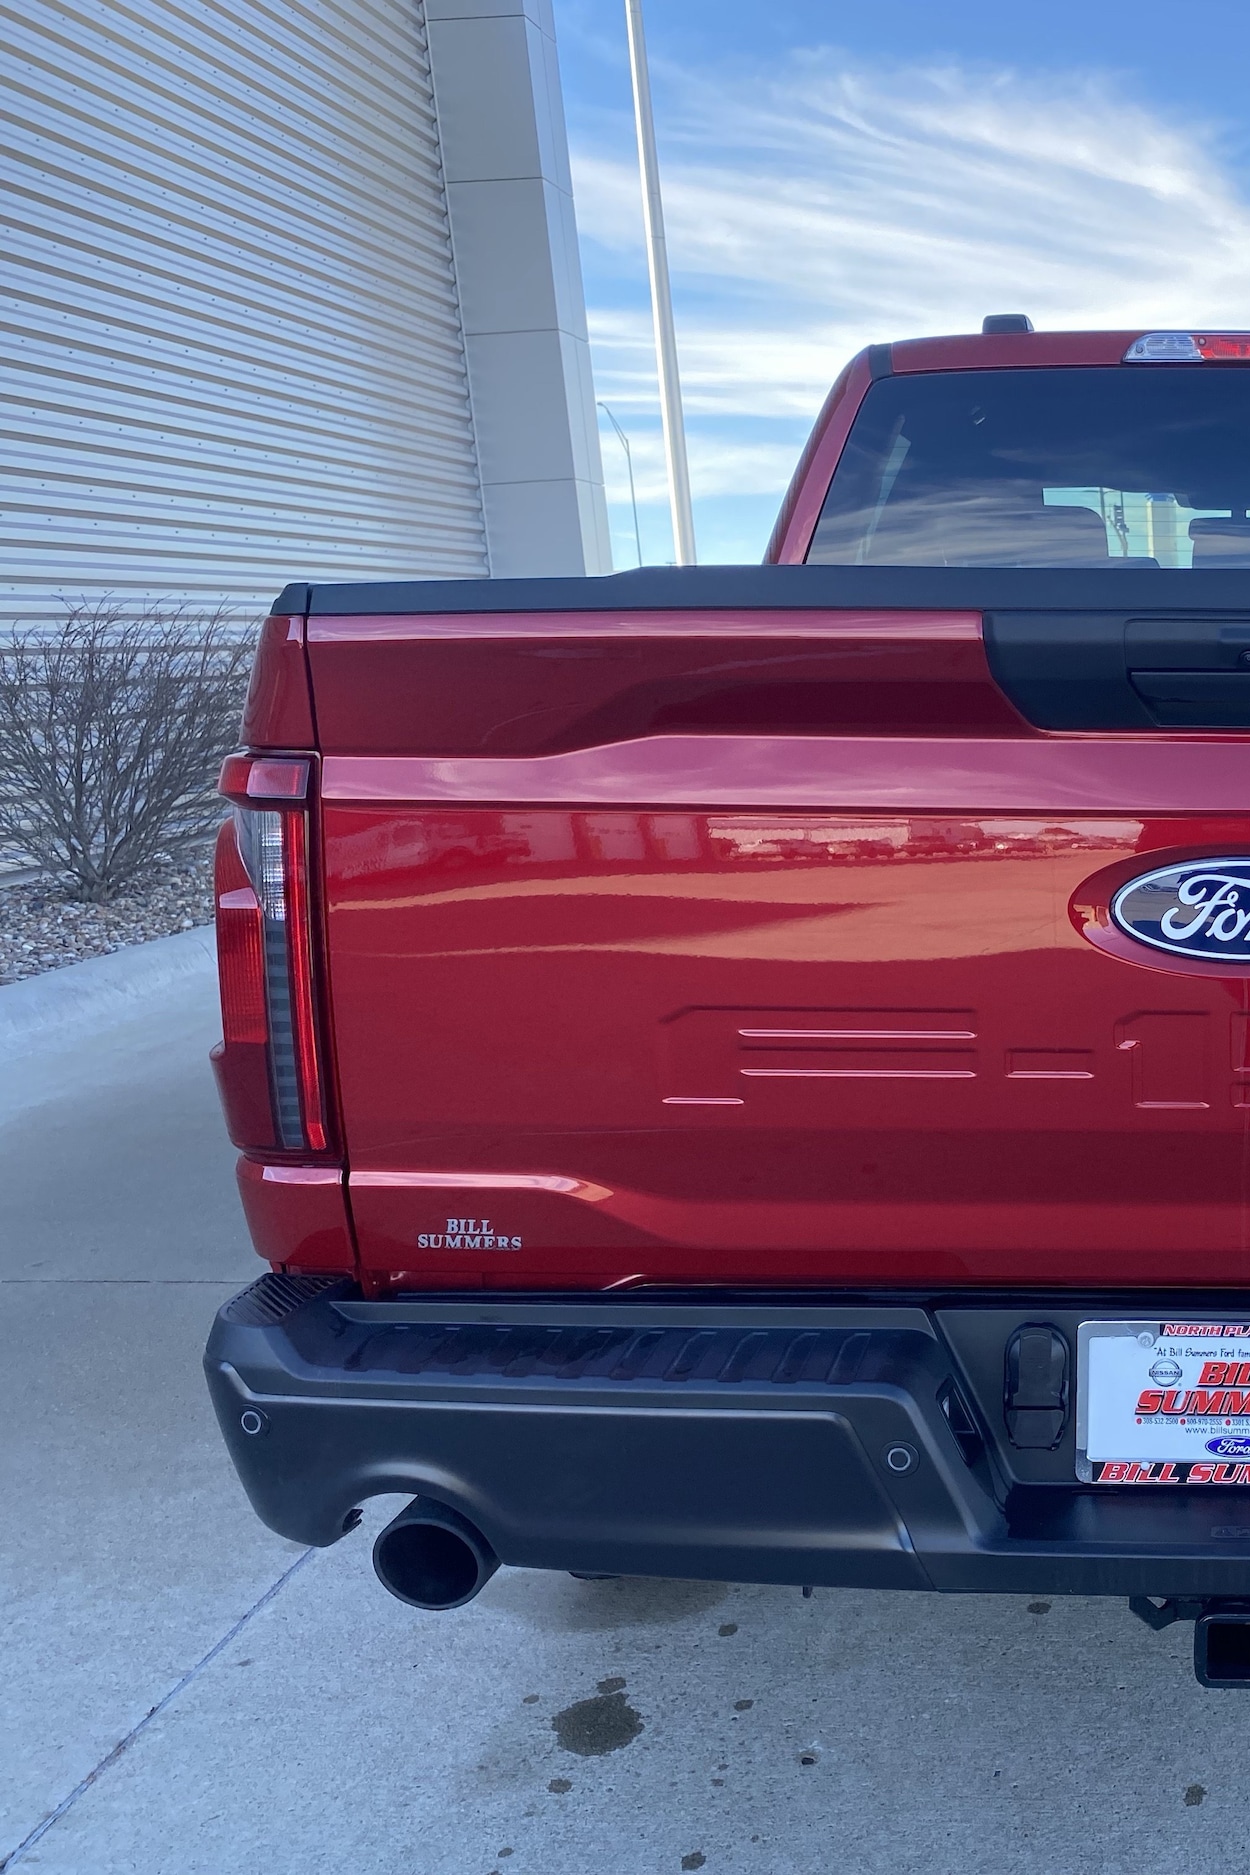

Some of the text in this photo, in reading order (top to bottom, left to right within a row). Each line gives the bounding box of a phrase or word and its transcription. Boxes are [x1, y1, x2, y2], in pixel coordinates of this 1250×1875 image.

[446, 1218, 494, 1234] BILL
[418, 1234, 522, 1249] SUMMERS
[1162, 1324, 1223, 1336] NORTH
[1169, 1347, 1183, 1357] Bill
[1185, 1347, 1218, 1358] Summers
[1220, 1348, 1235, 1358] Ford
[1098, 1462, 1182, 1483] BILL
